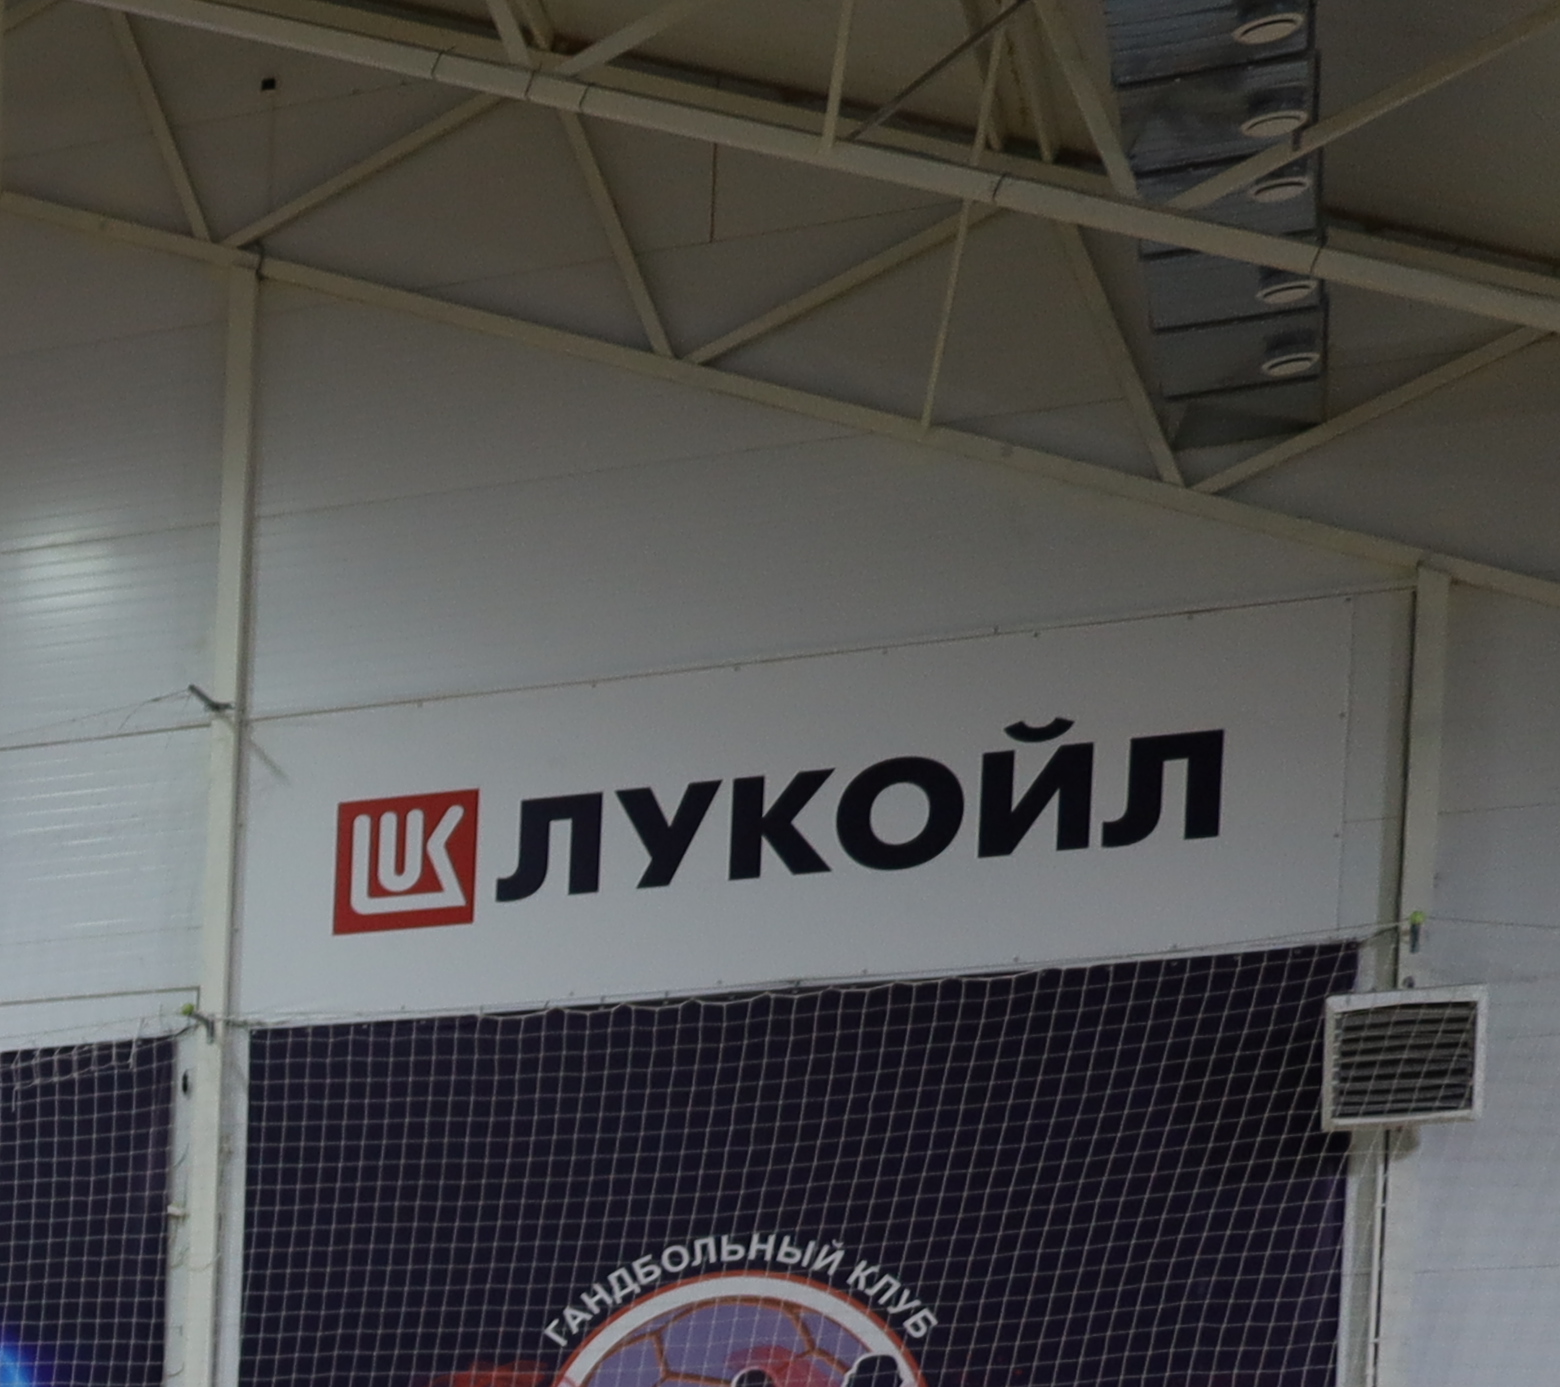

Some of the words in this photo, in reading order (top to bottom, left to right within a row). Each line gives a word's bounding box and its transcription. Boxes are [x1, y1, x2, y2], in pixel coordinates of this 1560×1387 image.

[494, 717, 1225, 904] ЛУКОЙЛ
[543, 1233, 845, 1347] ГАНДБОЛЬНЫЙ
[846, 1260, 938, 1339] КЛУБ
